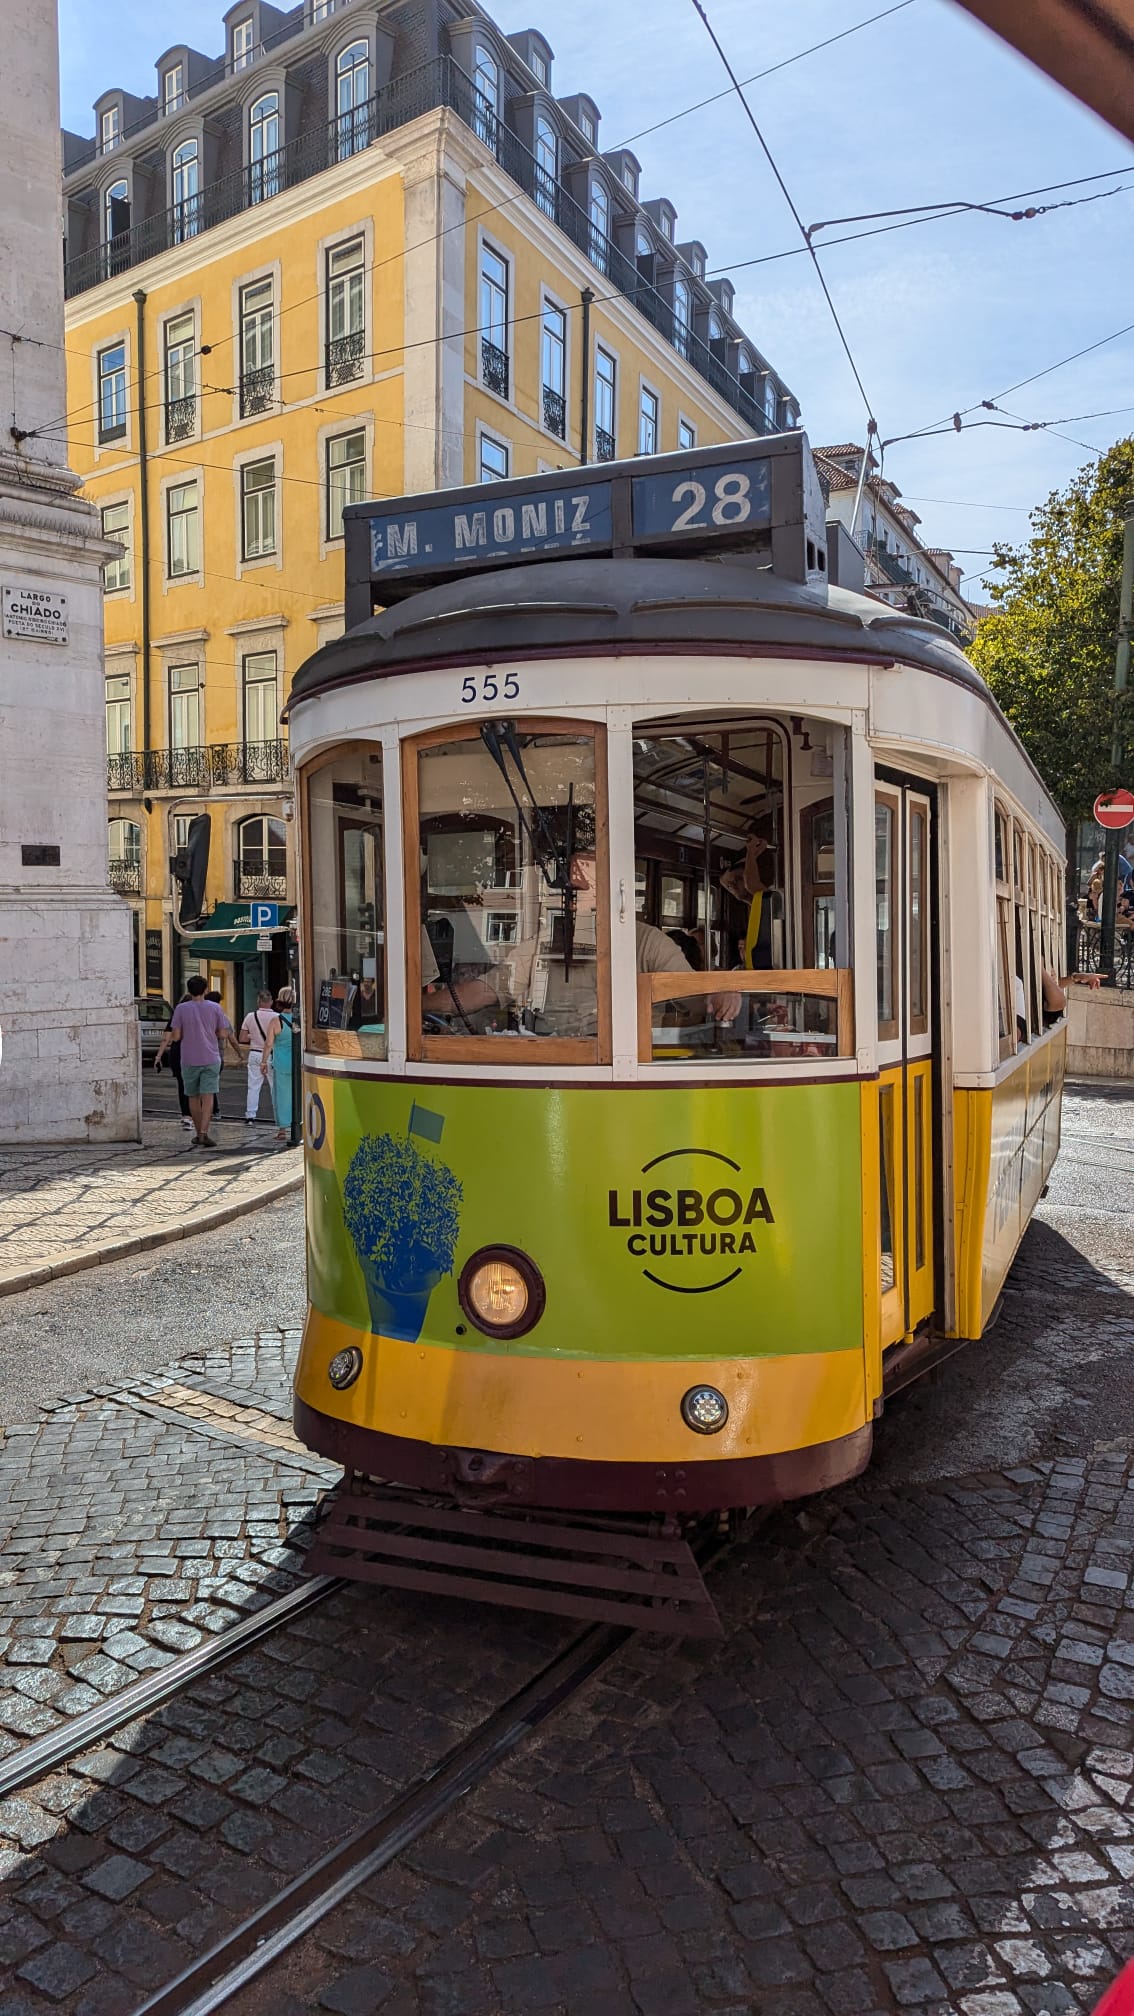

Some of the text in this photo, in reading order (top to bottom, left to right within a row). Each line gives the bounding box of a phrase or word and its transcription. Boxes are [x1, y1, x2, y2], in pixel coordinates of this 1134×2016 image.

[671, 472, 752, 532] 28
[386, 522, 433, 558] M.
[454, 495, 590, 549] MONIZ
[20, 592, 51, 602] LARGO
[11, 603, 61, 619] CHIADO
[461, 672, 520, 703] 555
[257, 906, 272, 928] P
[318, 1006, 329, 1022] 09
[608, 1187, 775, 1227] LISBOA
[627, 1231, 758, 1256] CULTURA
